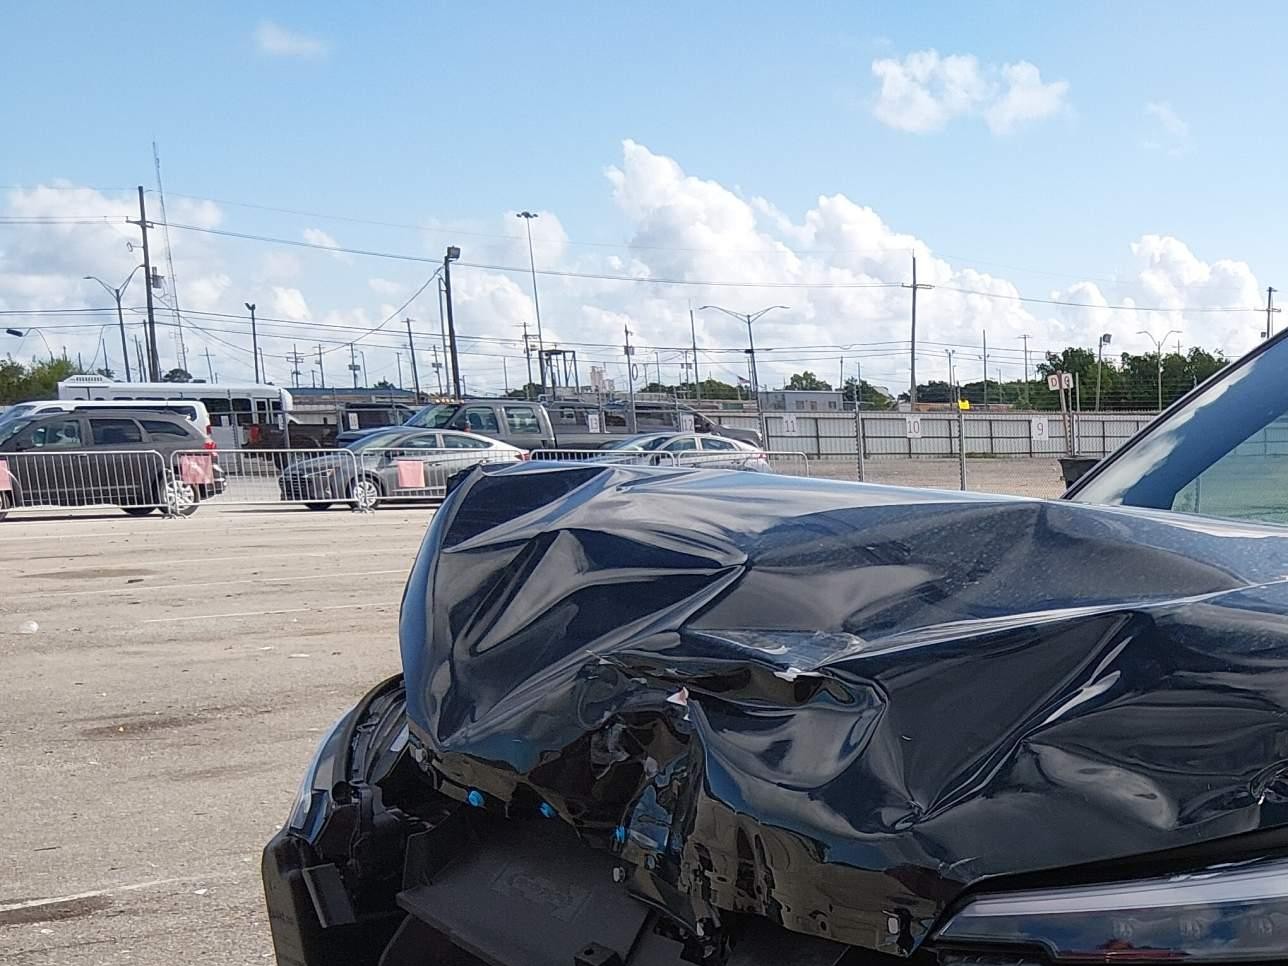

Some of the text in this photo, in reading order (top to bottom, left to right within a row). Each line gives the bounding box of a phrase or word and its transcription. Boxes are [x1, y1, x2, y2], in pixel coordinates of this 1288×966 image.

[784, 420, 796, 433] 11
[907, 420, 920, 434] 10
[1036, 422, 1044, 436] 9
